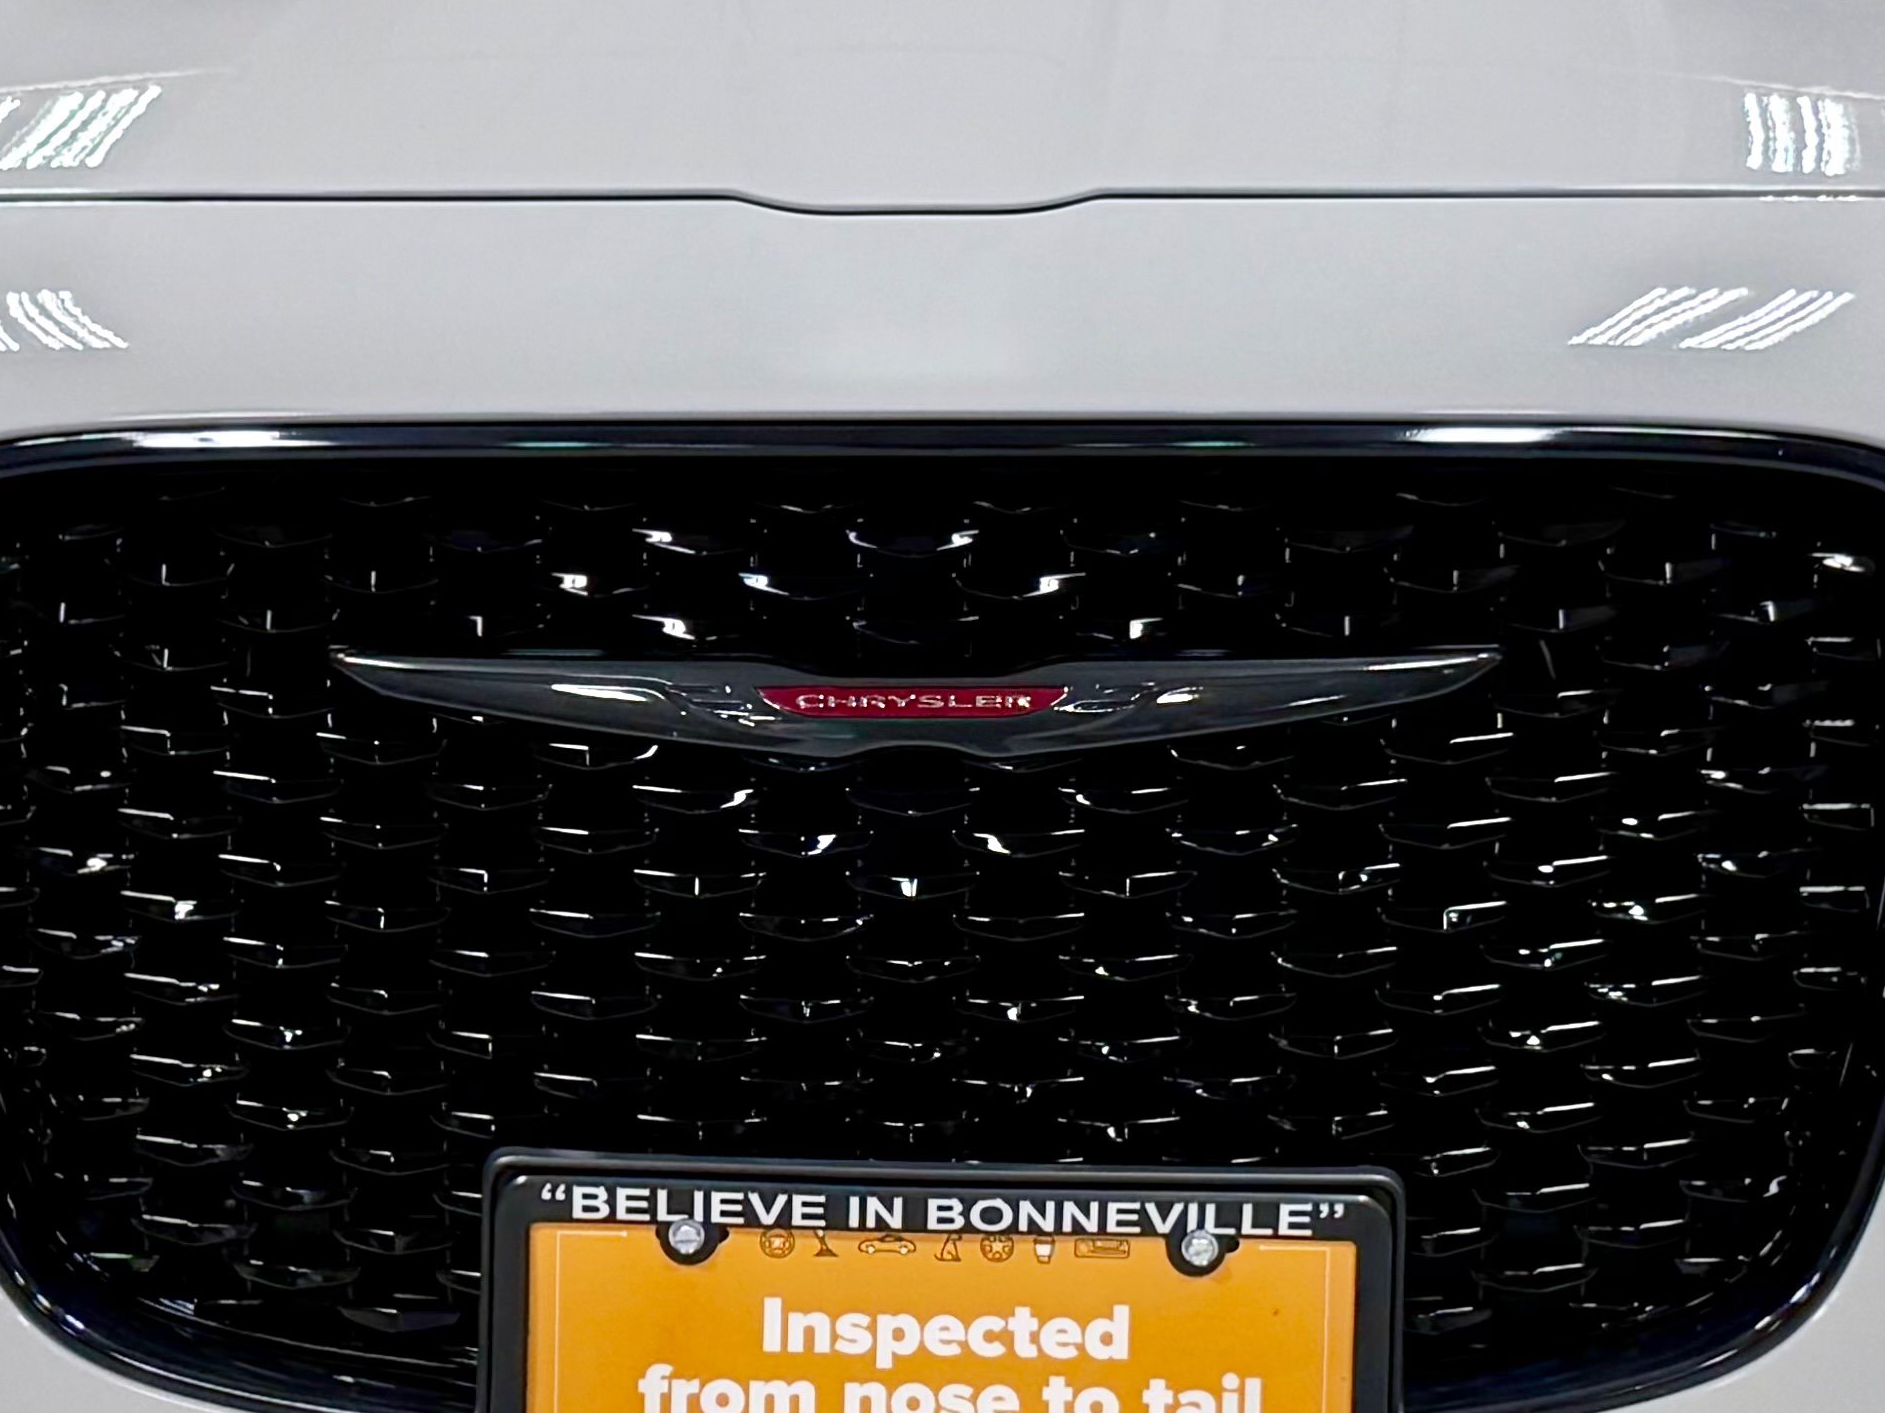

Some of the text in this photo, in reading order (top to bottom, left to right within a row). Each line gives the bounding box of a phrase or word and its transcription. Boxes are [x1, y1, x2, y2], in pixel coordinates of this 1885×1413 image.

[795, 693, 1032, 709] CHRYSLER
[848, 1195, 903, 1229] IN
[762, 1296, 1130, 1369] Inspected
